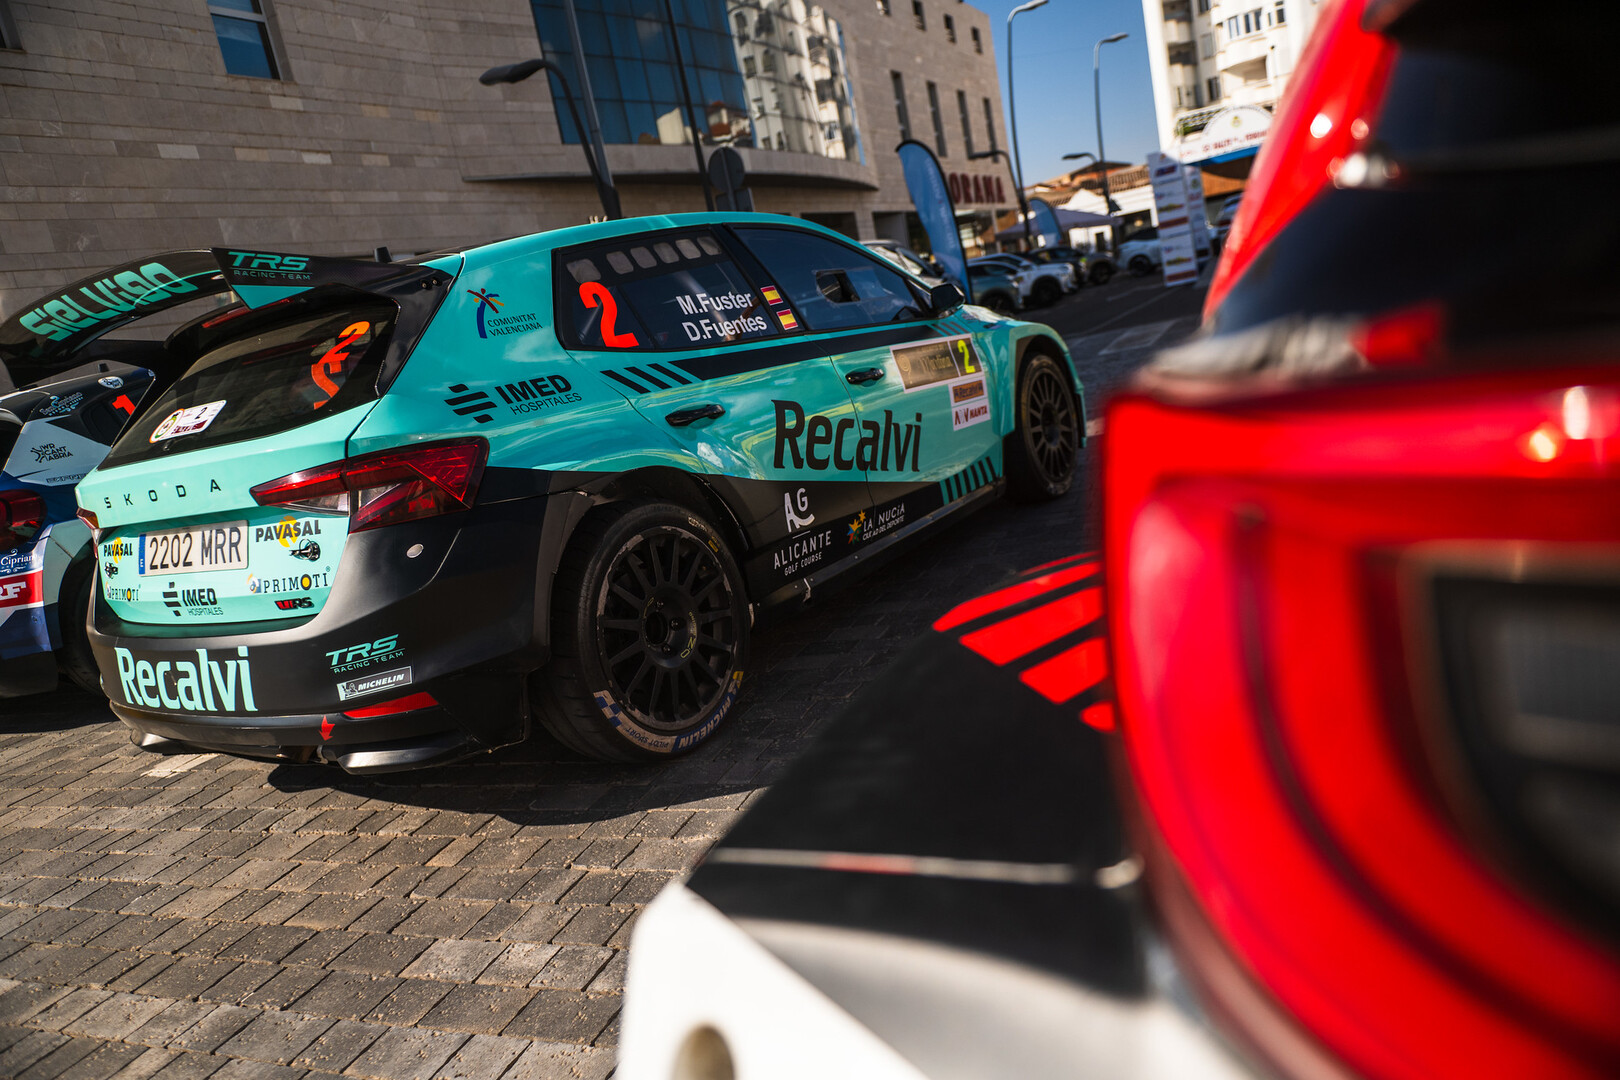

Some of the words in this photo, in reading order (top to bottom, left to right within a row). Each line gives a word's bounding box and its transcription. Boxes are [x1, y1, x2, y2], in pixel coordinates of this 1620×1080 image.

[949, 172, 1006, 205] ORAMA
[228, 251, 310, 271] TRS
[233, 269, 276, 279] RACING
[280, 272, 311, 280] TEAM
[579, 281, 639, 348] 2
[676, 289, 753, 315] M.Fuster
[488, 313, 537, 328] COMUNITAT
[489, 321, 542, 337] VALENCIANA
[682, 315, 767, 342] D.Fuentes
[311, 321, 370, 410] 2
[957, 340, 976, 373] 2
[495, 375, 573, 404] IMED
[510, 392, 582, 415] HOSPITALES
[771, 399, 922, 473] Recalvi
[256, 520, 322, 542] PAVASAL
[103, 543, 133, 557] PAVASAL
[149, 532, 193, 570] 2202
[201, 526, 242, 565] MRR
[774, 530, 832, 570] ALICANTE
[783, 562, 799, 576] GOLF
[800, 551, 823, 568] COURSE
[111, 587, 139, 602] PRIMOTI
[263, 572, 329, 594] PRIMOTI
[182, 588, 218, 607] IMED
[187, 607, 224, 617] HOSPITALES
[325, 634, 399, 666] TRS
[333, 660, 370, 674] RACING
[374, 651, 404, 663] TEAM
[114, 645, 258, 712] Recalvi
[358, 674, 404, 691] MICHELIN
[677, 695, 732, 749] MICHELIN
